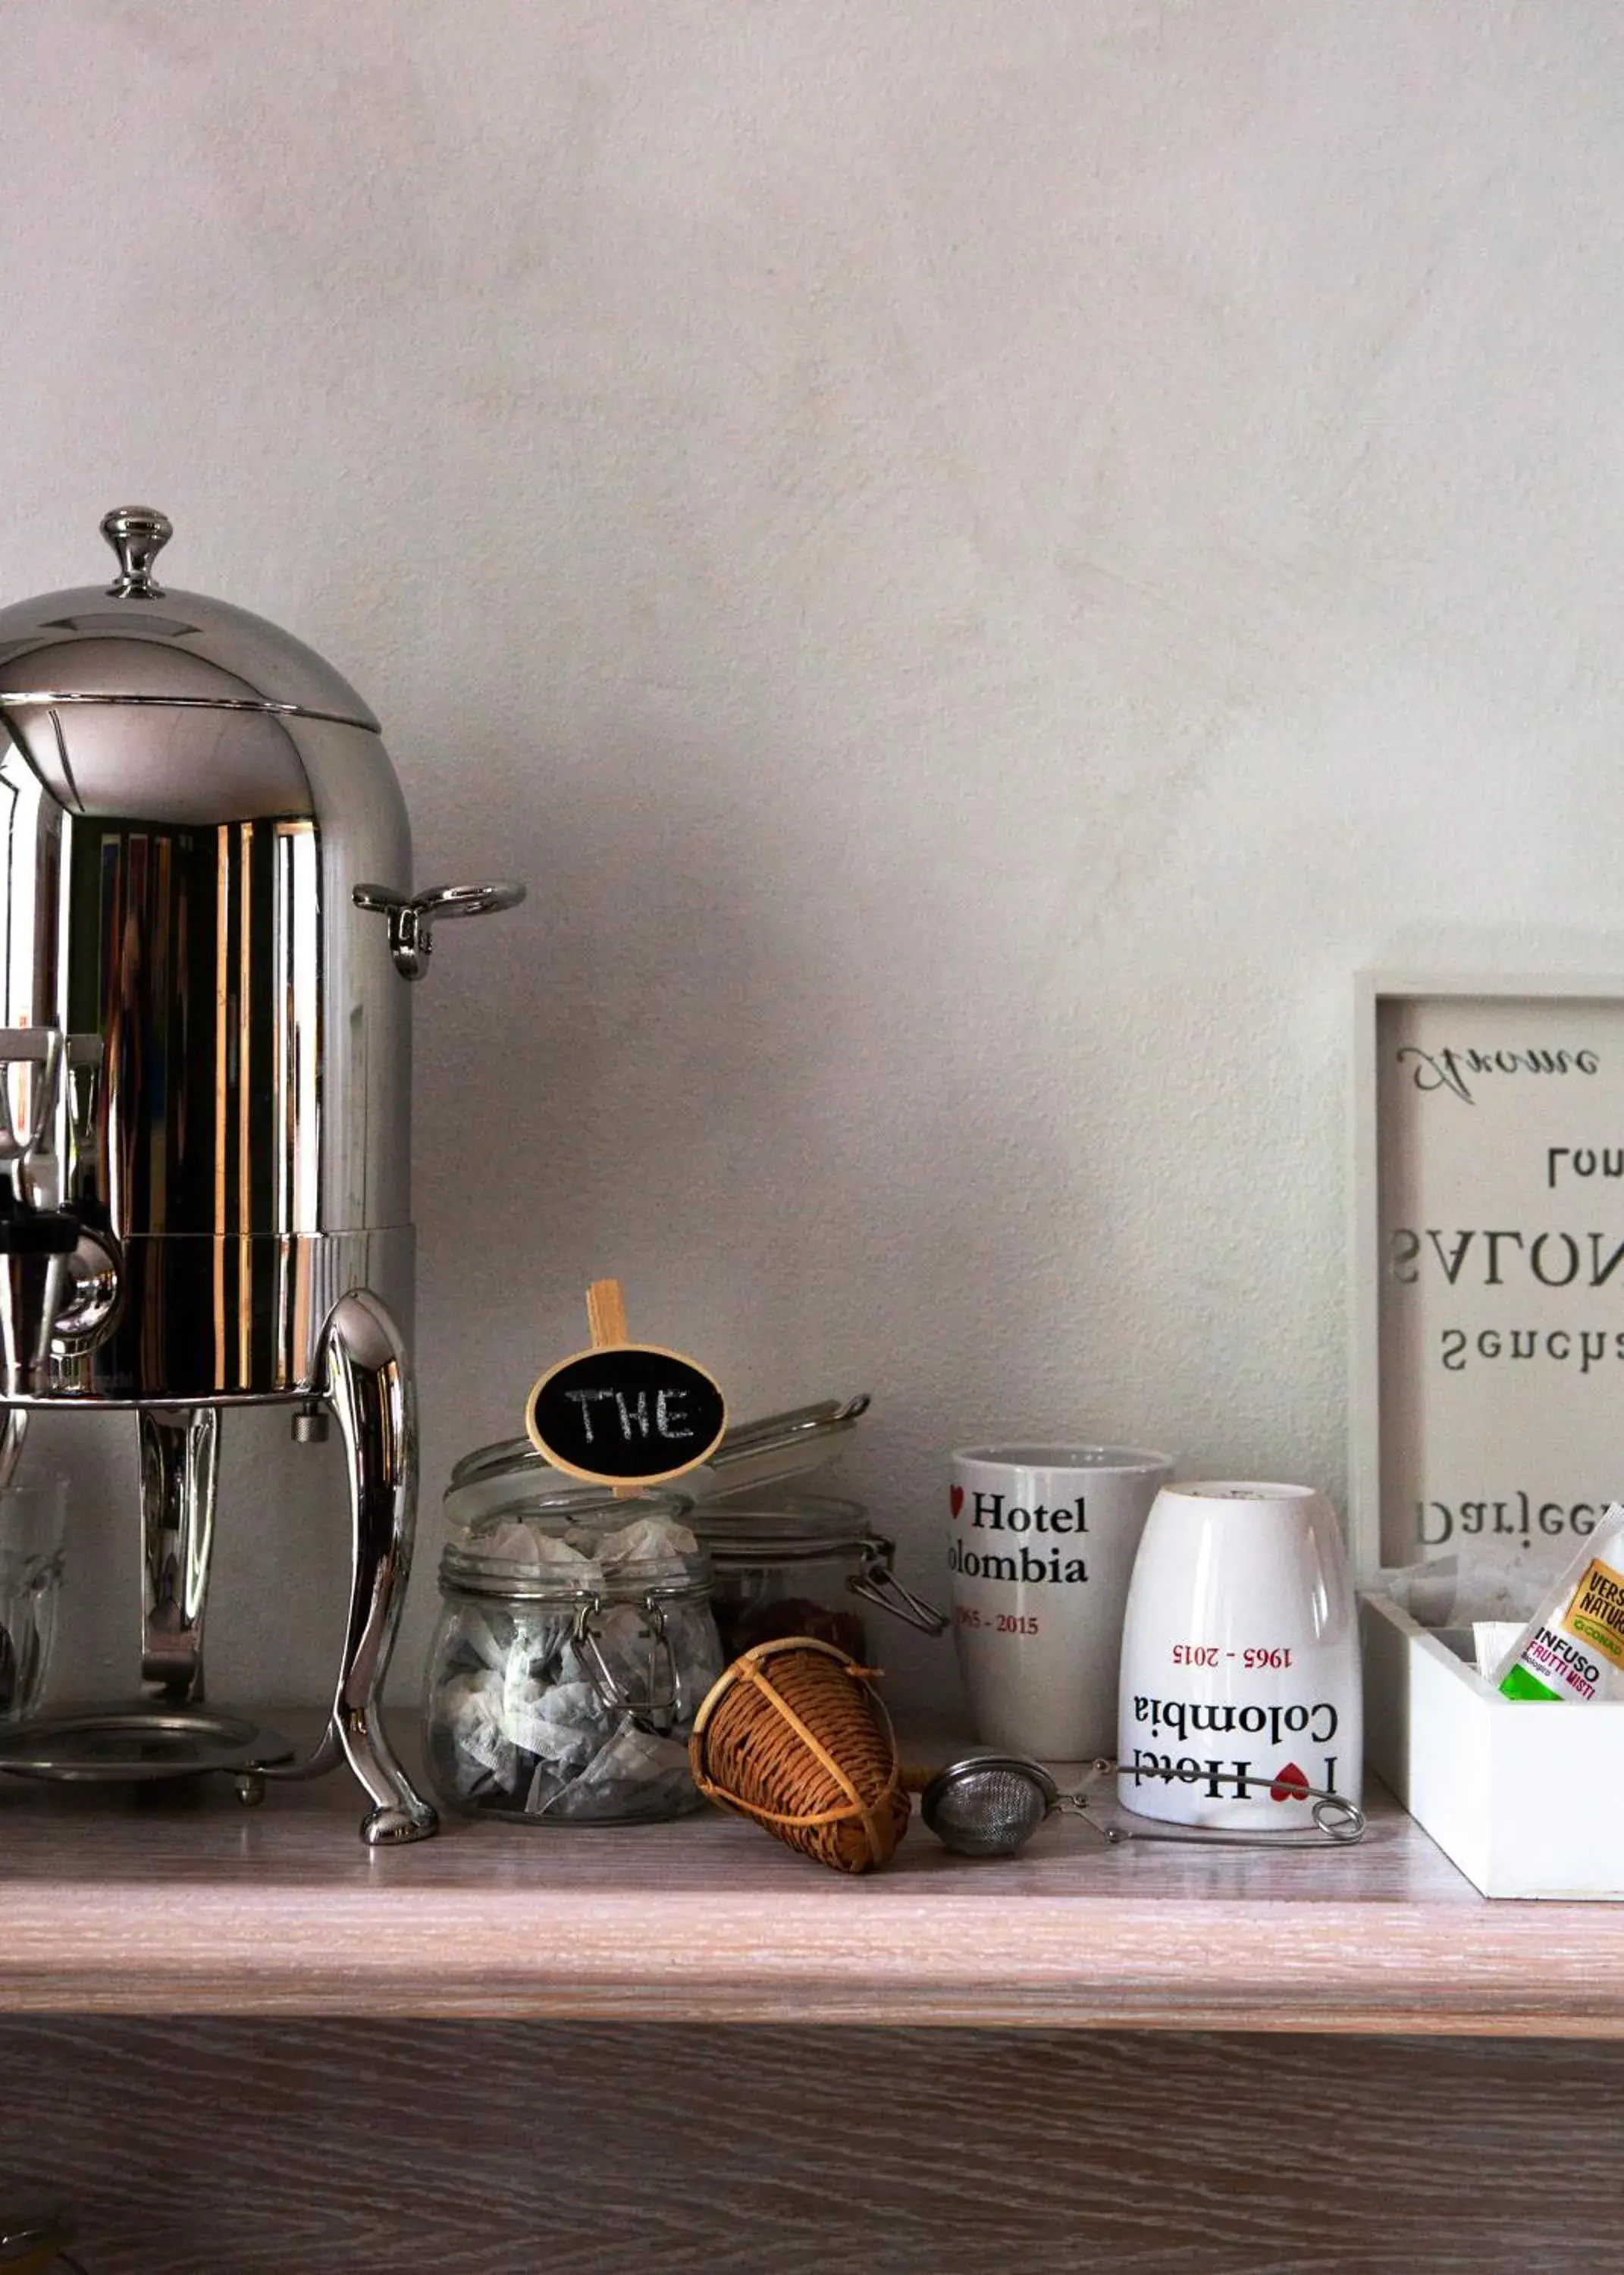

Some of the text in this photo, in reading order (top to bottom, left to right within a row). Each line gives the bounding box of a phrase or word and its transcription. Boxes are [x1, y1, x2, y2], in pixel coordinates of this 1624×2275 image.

[565, 1388, 694, 1443] THE
[972, 1492, 1089, 1533] Hotel
[948, 1539, 1089, 1583] olombia
[996, 1614, 1039, 1636] 2015
[1173, 1645, 1219, 1668] 2015
[1243, 1649, 1293, 1668] 1965
[1526, 1640, 1596, 1701] FRUTTI MISTI
[1535, 1627, 1599, 1683] INFUSO
[1133, 1696, 1338, 1746] Colombia
[1133, 1749, 1338, 1800] I Hotel
